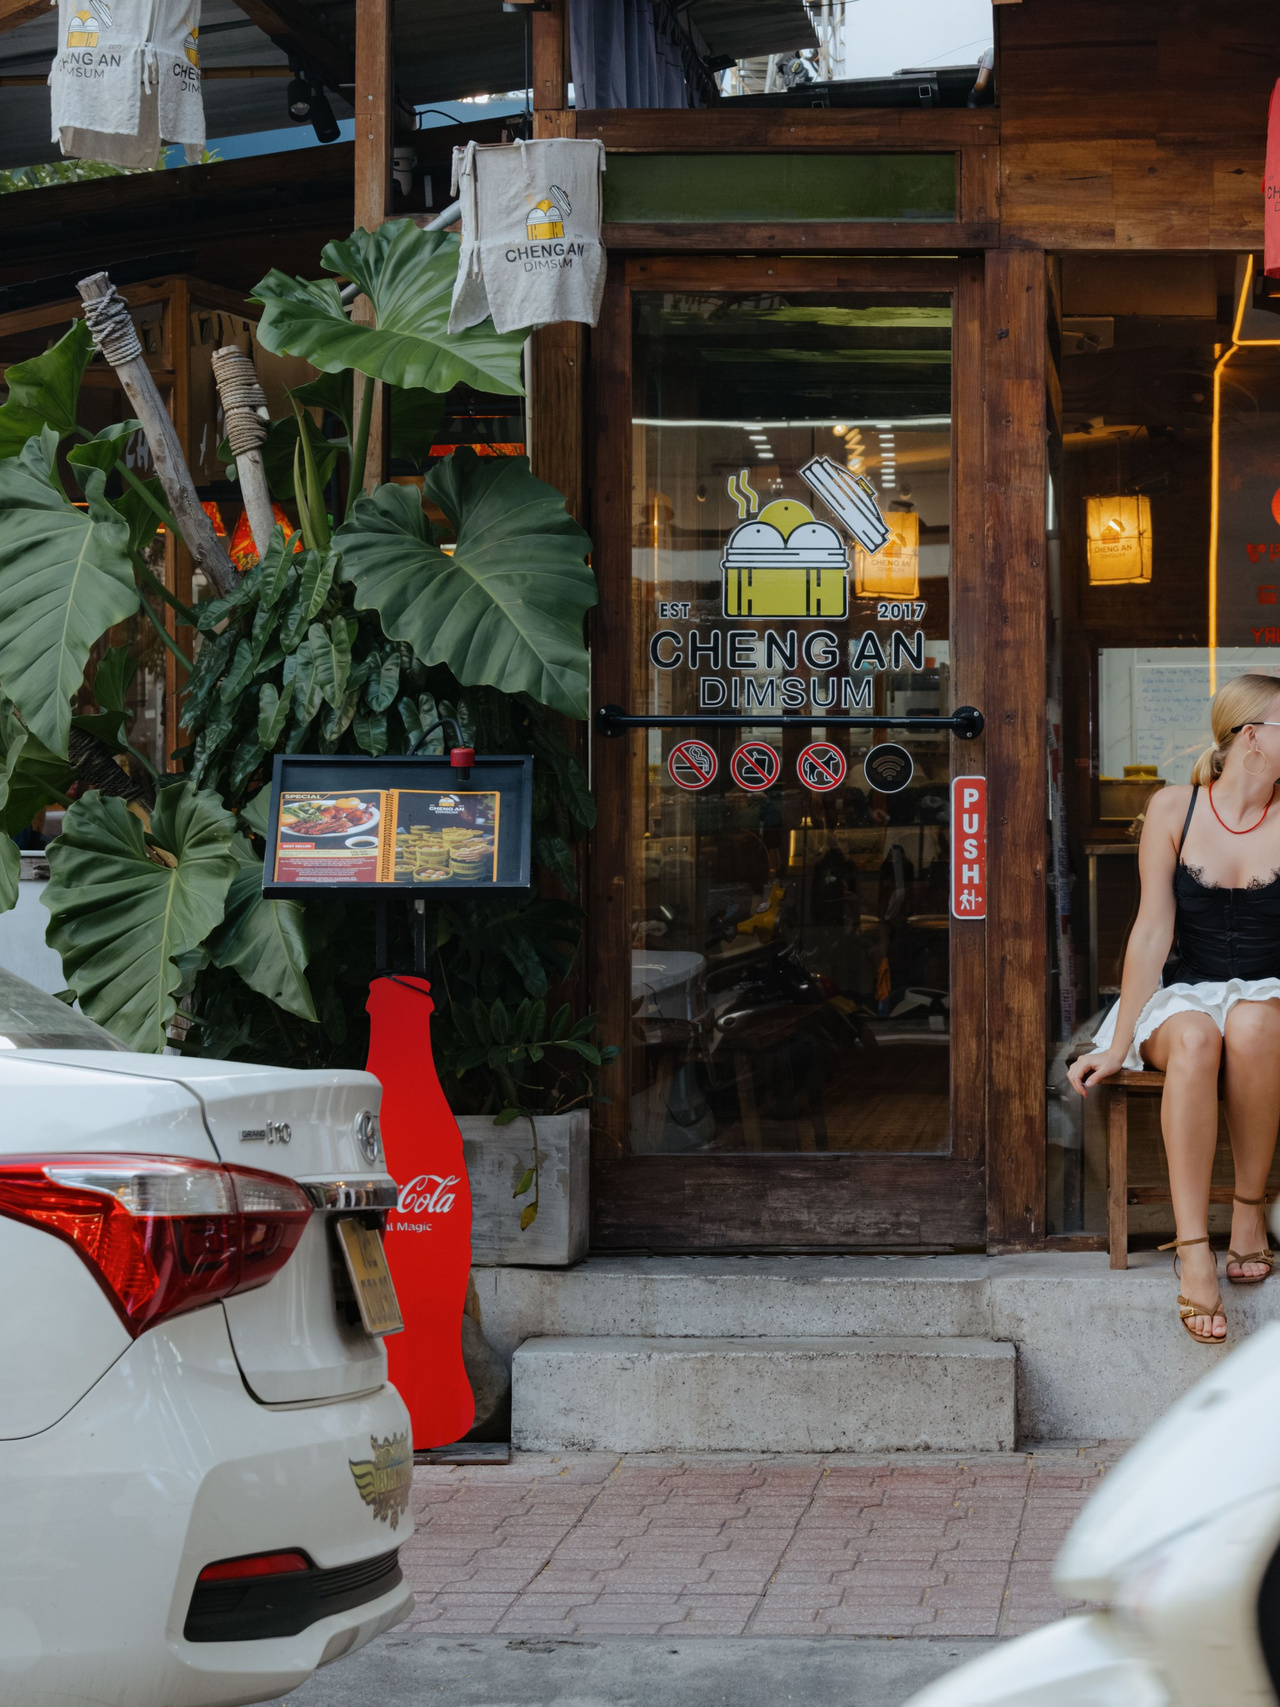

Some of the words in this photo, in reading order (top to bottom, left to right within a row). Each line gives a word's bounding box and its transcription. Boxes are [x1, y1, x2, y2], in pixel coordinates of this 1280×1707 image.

[98, 54, 122, 67] AN
[66, 67, 105, 79] MSUM
[505, 243, 565, 263] CHENG
[566, 242, 585, 257] AN
[659, 602, 691, 619] EST
[877, 602, 926, 620] 2017
[650, 629, 840, 671] CHENG
[851, 629, 925, 671] AN
[700, 677, 873, 709] DIMSUM
[962, 788, 980, 884] PUSH
[242, 1130, 265, 1138] GRAND
[397, 1222, 433, 1233] Magic
